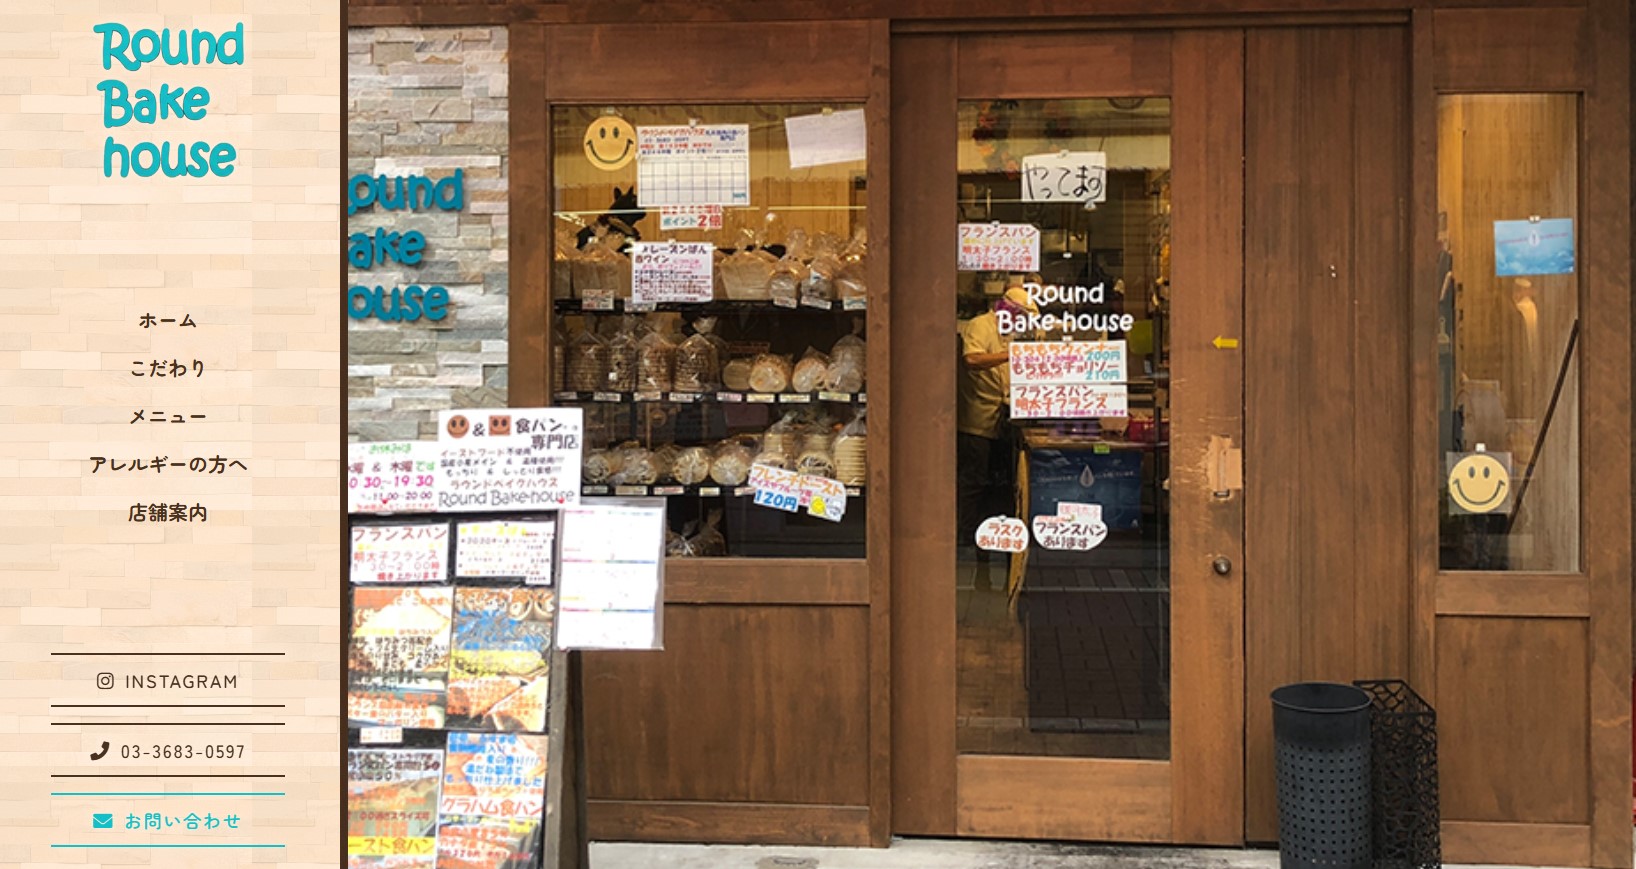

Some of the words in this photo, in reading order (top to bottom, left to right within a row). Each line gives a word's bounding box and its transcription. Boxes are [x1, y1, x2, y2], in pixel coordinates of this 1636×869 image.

[1023, 163, 1106, 201] やってます
[348, 168, 464, 215] ound
[960, 226, 1037, 238] フランスパン
[348, 227, 426, 270] ake
[1023, 282, 1105, 306] Round
[348, 285, 449, 321] ouse
[996, 309, 1134, 335] Bake-house
[1015, 385, 1094, 399] フランスパン
[438, 491, 487, 507] Round
[755, 489, 798, 511] 120円
[353, 526, 447, 541] フランスパン
[988, 522, 1023, 537] ラスク
[1035, 522, 1106, 537] フランスパン
[979, 535, 1024, 549] あります
[1043, 536, 1090, 548] あります
[348, 838, 435, 855] ースト食パン
